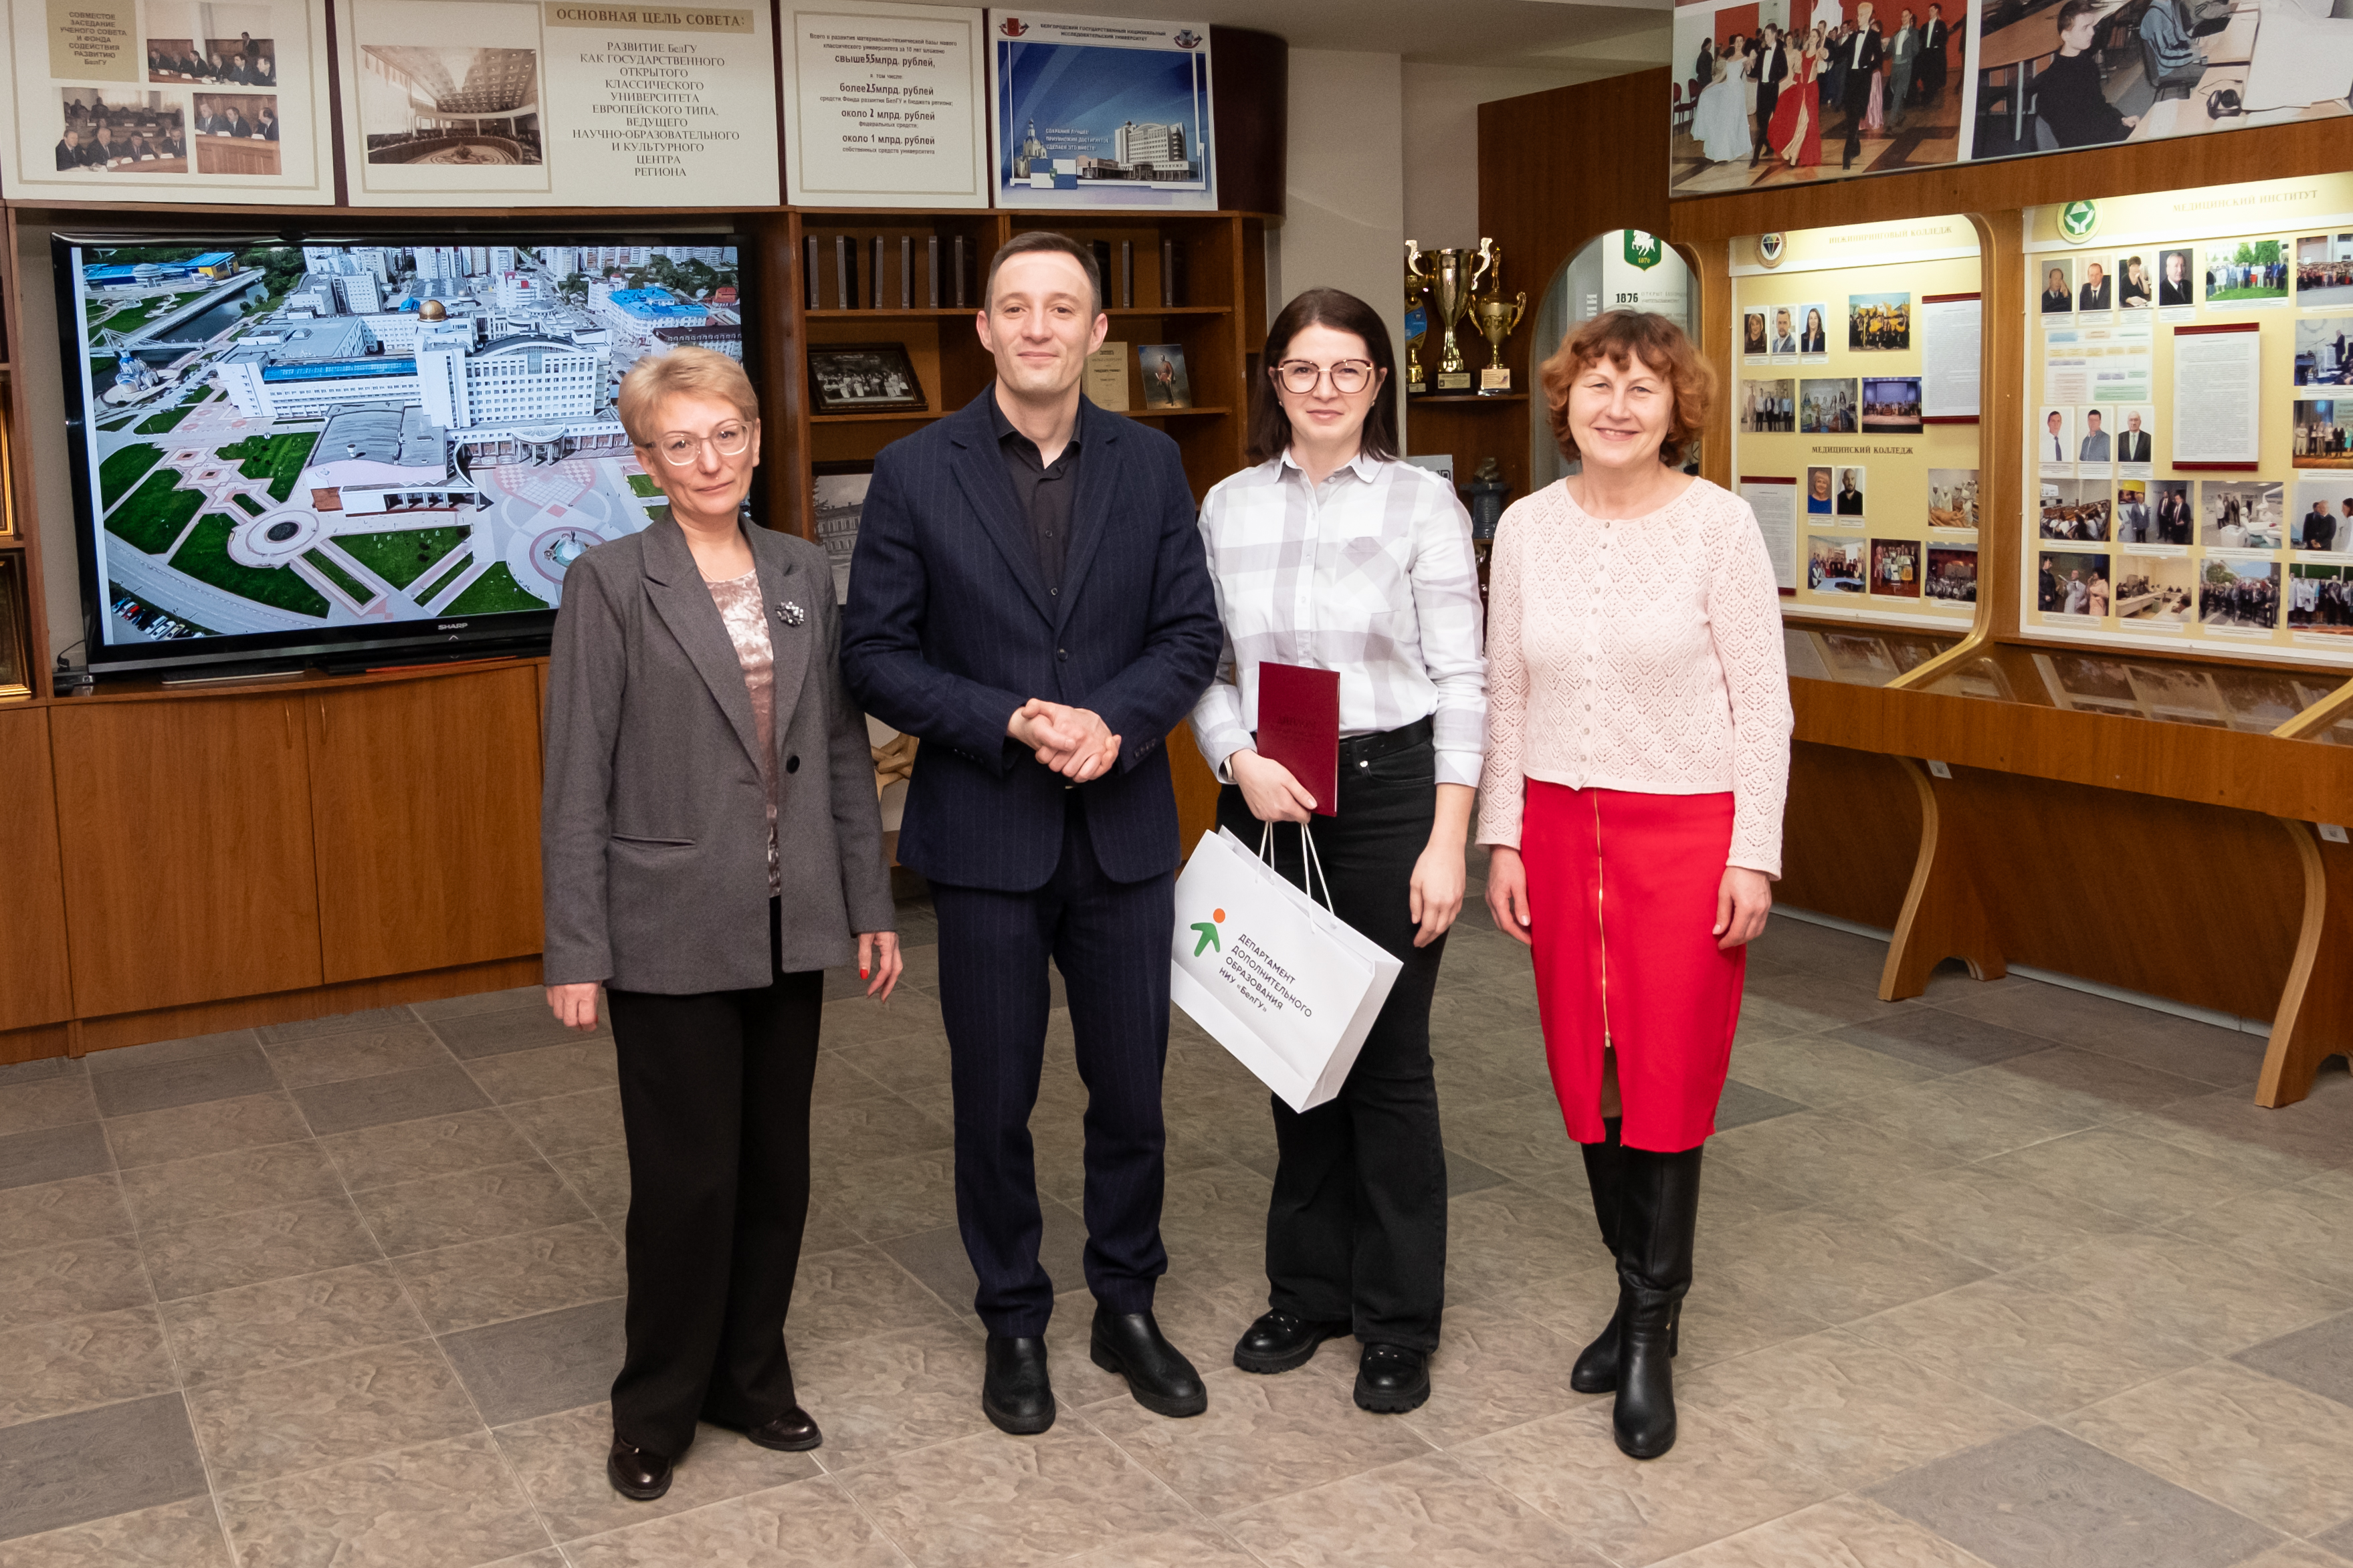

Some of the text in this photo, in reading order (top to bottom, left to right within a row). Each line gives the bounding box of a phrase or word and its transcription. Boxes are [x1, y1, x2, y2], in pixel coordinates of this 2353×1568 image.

[70, 19, 116, 27] ЗАСЕДАНИЕ
[556, 9, 744, 27] ОСНОВНАЯ ЦЕЛЬ СОВЕТА:
[84, 35, 112, 43] ФОНДА
[68, 43, 120, 51] СОДЕЙСТВИЯ
[607, 41, 698, 53] РАЗВИТИЕ БелГУ
[74, 51, 116, 59] РАЗВИТИЮ
[580, 53, 725, 67] КАК ГОСУДАРСТВЕННОГО
[835, 55, 865, 64] свыше
[902, 56, 935, 68] рублей,
[619, 68, 689, 78] ОТКРЫТОГО
[605, 79, 704, 91] КЛАССИЧЕСКОГО
[839, 82, 866, 92] более
[903, 86, 934, 96] рублей
[611, 92, 700, 103] УНИВЕРСИТЕТА
[592, 104, 683, 116] ЕВРОПЕЙСКОГО
[841, 108, 935, 121] около 2 млрд. рублей
[626, 117, 688, 128] ВЕДУЩЕГО
[573, 129, 740, 140] НАУЧНО-ОБРАЗОВАТЕЛЬНОГО
[842, 135, 868, 143] около
[878, 136, 903, 146] млрд.
[904, 136, 935, 146] рублей
[611, 142, 704, 152] И КУЛЬТУРНОГО
[636, 155, 681, 165] ЦЕНТРА
[635, 168, 687, 177] РЕГИОНА
[2173, 190, 2318, 213] МЕДИЦИНСКИЙ ИНСТИТУТ
[1829, 226, 1952, 244] ИНЖИНИРИНГОВЫЙ КОЛЛЕДЖ
[1615, 292, 1639, 304] 1876
[1812, 445, 1914, 455] МЕДИЦИНСКИЙ КОЛЛЕДЖ
[438, 623, 468, 631] SHARP
[1238, 933, 1296, 984] ДЕПАРТАМЕНТ
[1226, 956, 1284, 1010] ОБРАЗОВАНИЯ
[1231, 945, 1312, 1017] ДОПОЛНИТЕЛЬНОГО
[1219, 967, 1267, 1012] НИУ «БелГУ»
